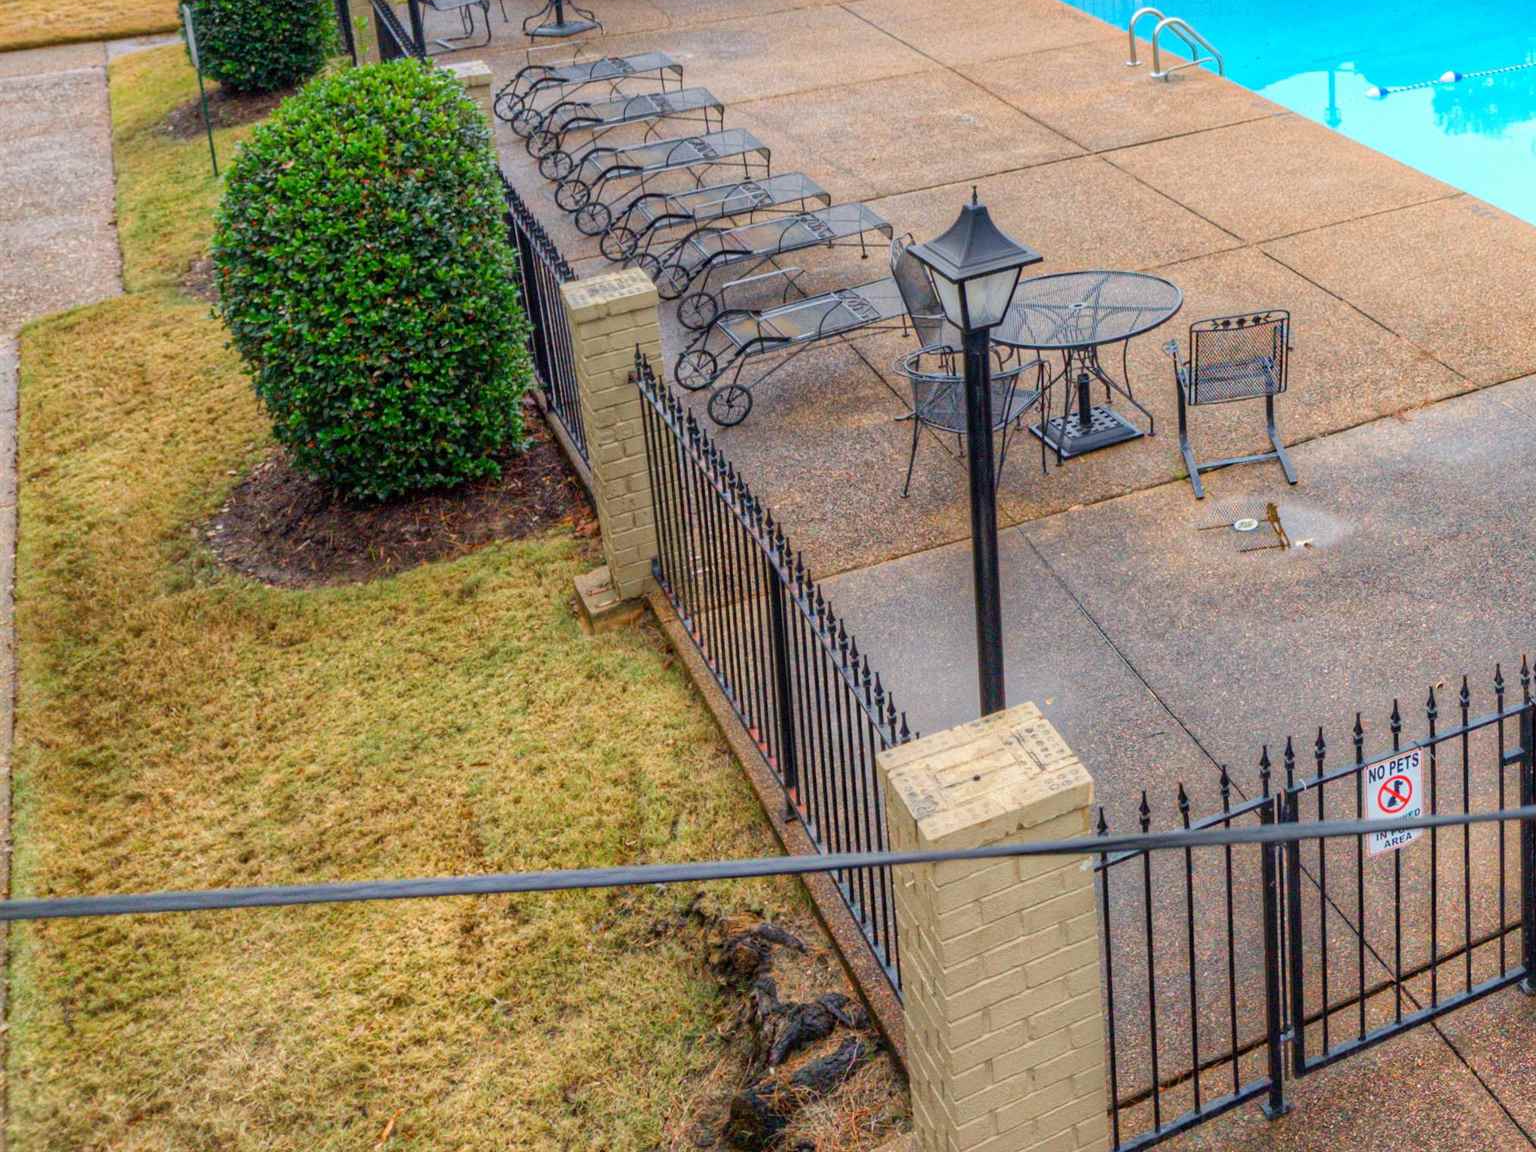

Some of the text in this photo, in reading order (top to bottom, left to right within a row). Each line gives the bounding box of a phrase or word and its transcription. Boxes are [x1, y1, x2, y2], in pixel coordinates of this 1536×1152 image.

[1368, 752, 1420, 784] NO PETS
[1376, 831, 1387, 841] IN
[1384, 832, 1412, 848] AREA
